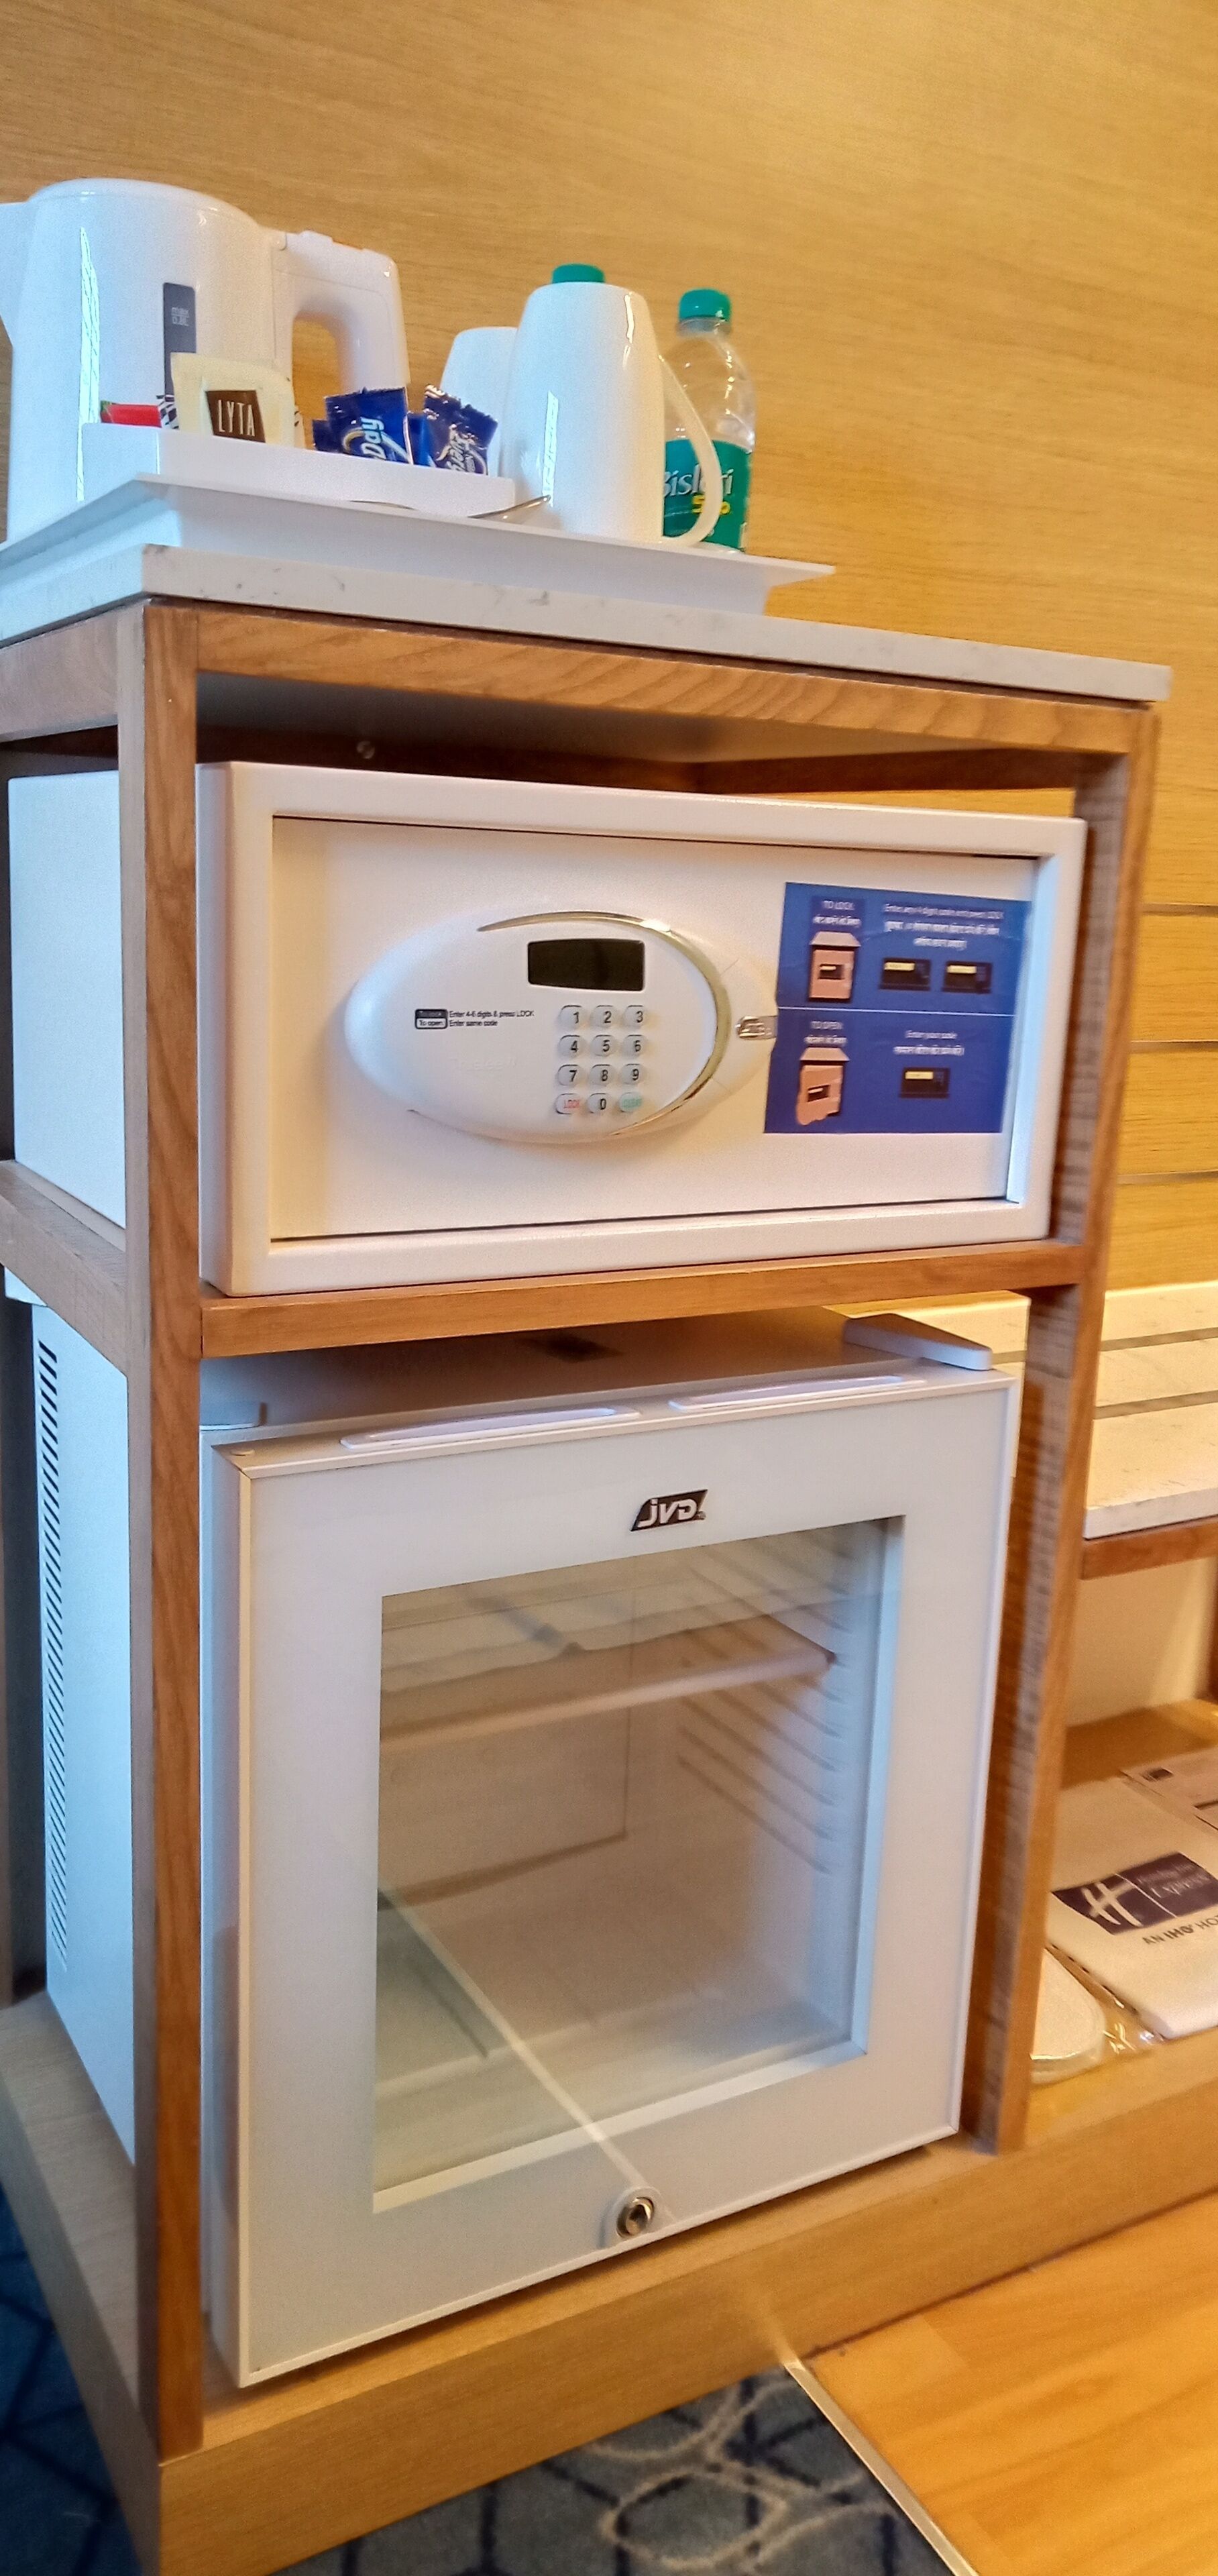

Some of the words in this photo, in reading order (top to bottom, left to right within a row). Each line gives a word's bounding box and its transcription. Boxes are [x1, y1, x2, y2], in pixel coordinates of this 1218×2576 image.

[218, 399, 256, 437] LYTA
[573, 1012, 579, 1024] 1
[604, 1011, 612, 1023] 2
[636, 1011, 643, 1023] 3
[570, 1040, 578, 1053] 4
[602, 1040, 610, 1052] 5
[634, 1040, 641, 1052] 6
[569, 1069, 577, 1082] 7
[601, 1069, 608, 1081] 8
[632, 1069, 639, 1081] 9
[600, 1098, 606, 1110] 0
[1142, 1935, 1166, 1945] AN
[1195, 1915, 1218, 1930] HO
